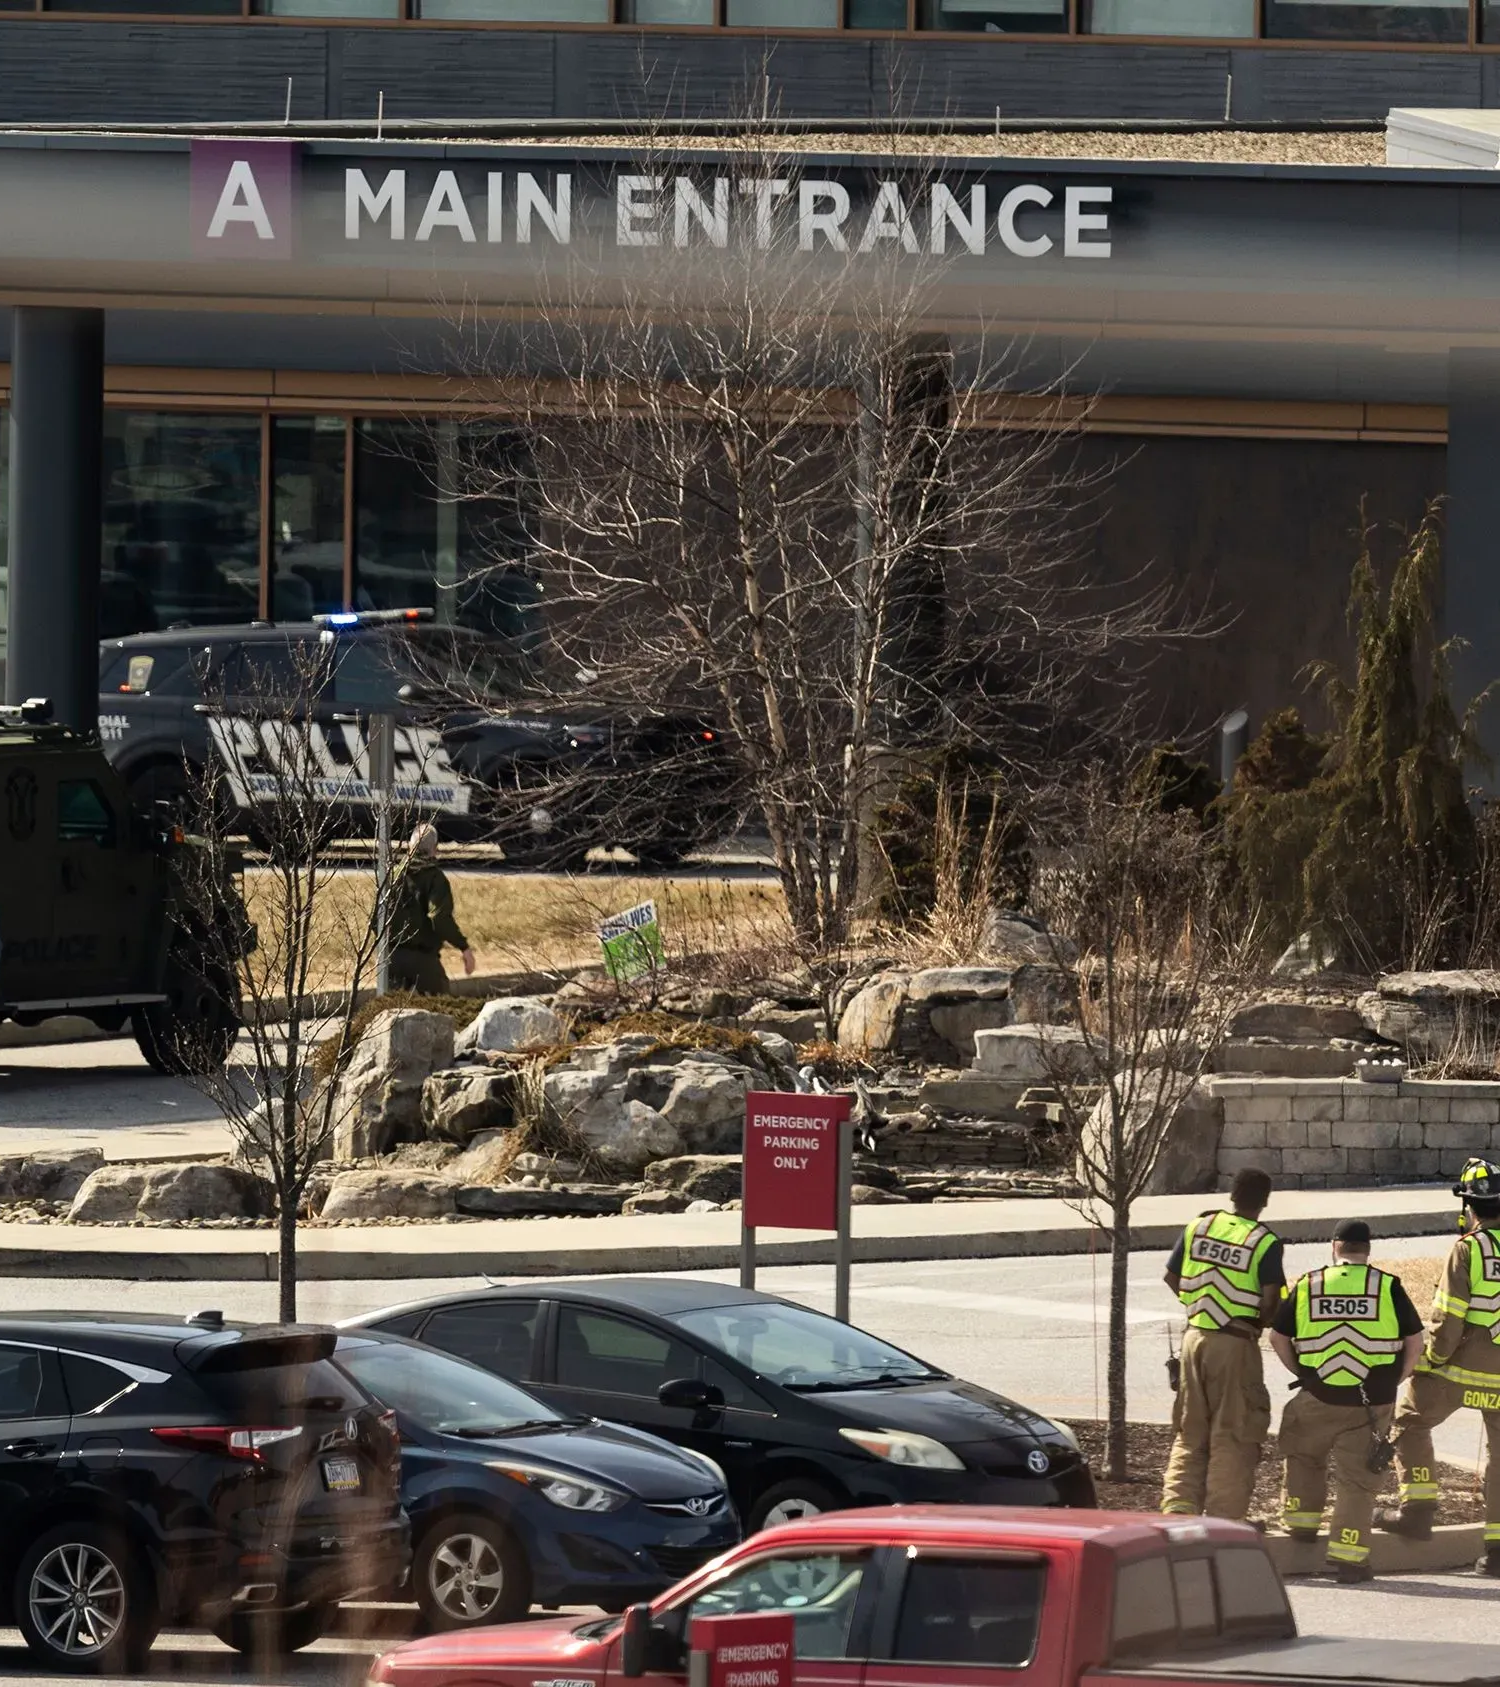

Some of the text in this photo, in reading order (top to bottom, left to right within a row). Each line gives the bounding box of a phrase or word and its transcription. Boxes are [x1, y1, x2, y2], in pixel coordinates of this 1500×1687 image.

[206, 160, 275, 240] A
[343, 167, 1114, 259] MAIN ENTRANCE
[98, 715, 131, 728] DIAL
[753, 1114, 830, 1131] EMERGENCY
[764, 1135, 820, 1150] PARKING
[773, 1156, 809, 1170] ONLY
[1199, 1241, 1242, 1266] R505
[1318, 1298, 1369, 1315] R505
[1411, 1467, 1430, 1482] 50
[1340, 1529, 1360, 1545] 50
[716, 1643, 790, 1664] EMERGENCY
[725, 1669, 779, 1687] PARKING
